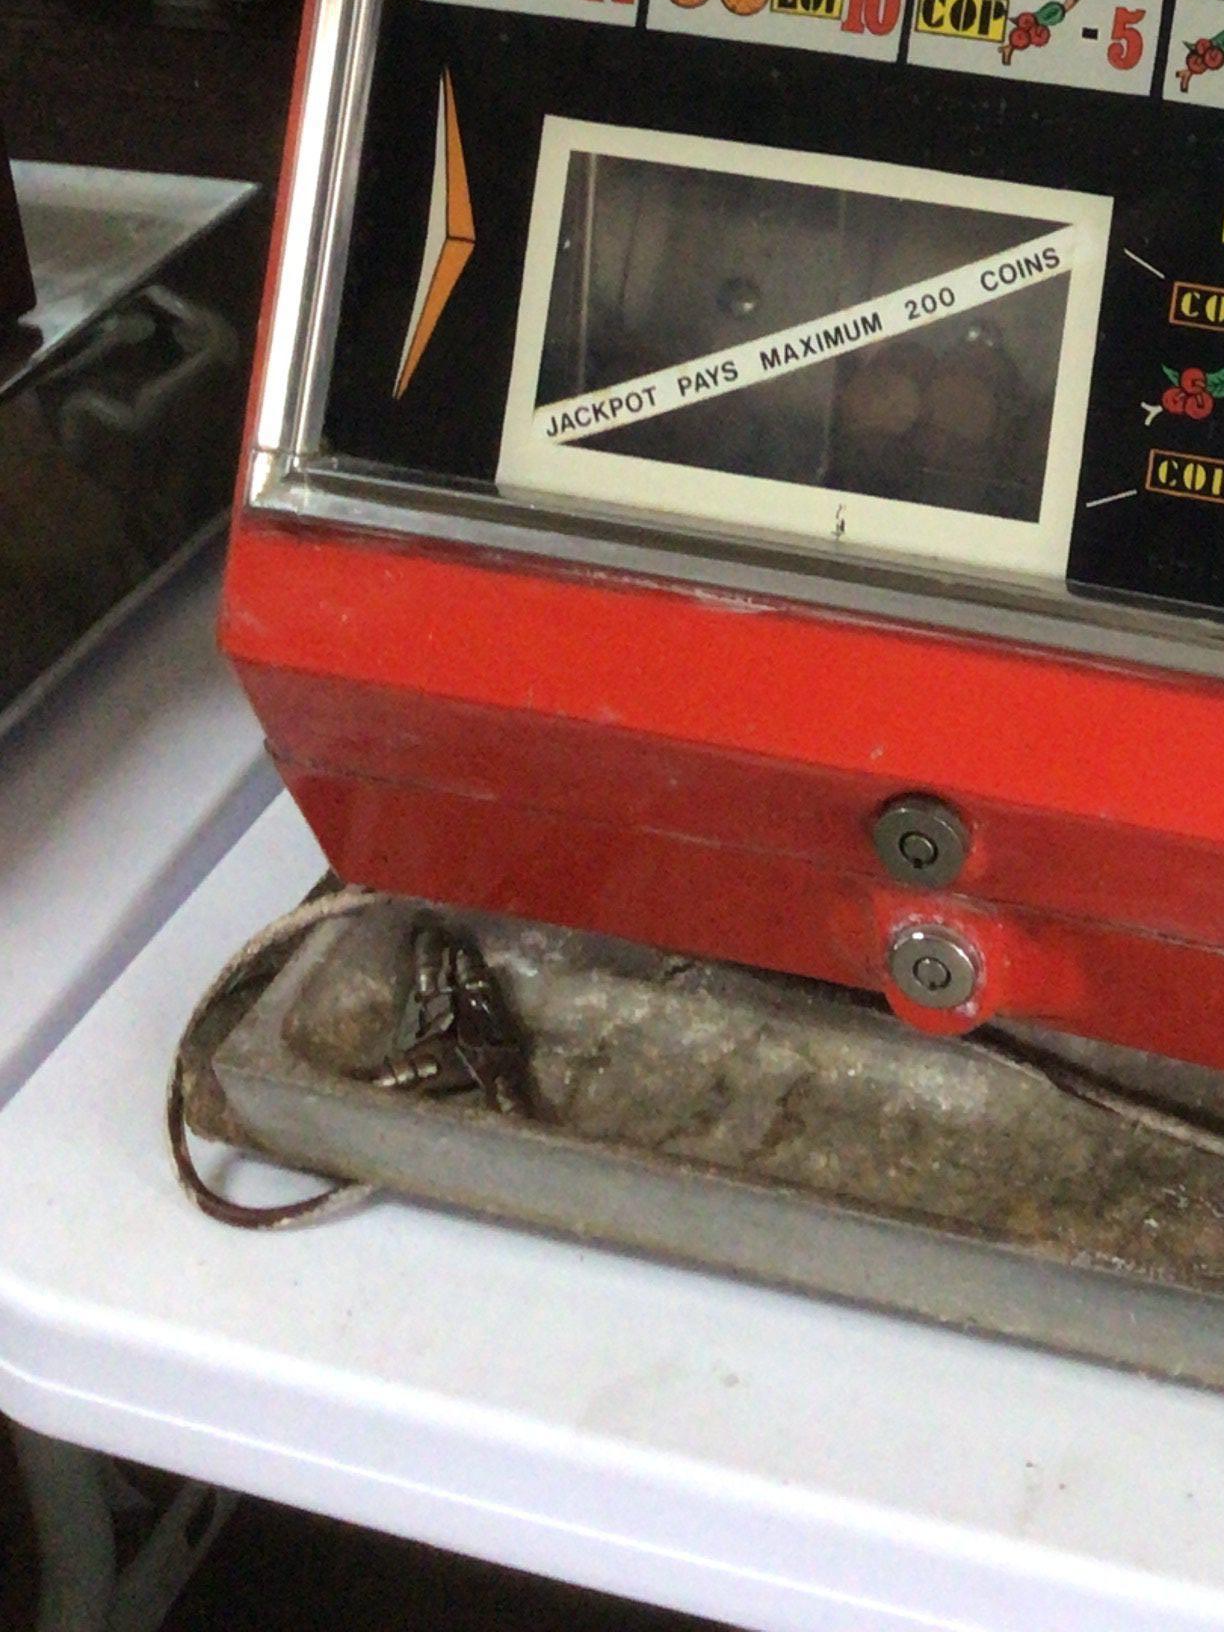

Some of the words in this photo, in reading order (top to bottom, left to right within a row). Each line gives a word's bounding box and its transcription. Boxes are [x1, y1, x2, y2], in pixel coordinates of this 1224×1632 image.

[1106, 5, 1147, 71] 5
[545, 385, 658, 437] JACKPOT
[676, 360, 739, 397] PAYS
[759, 311, 883, 371] MAXIMUM
[904, 286, 957, 321] 200
[979, 246, 1061, 292] COINS
